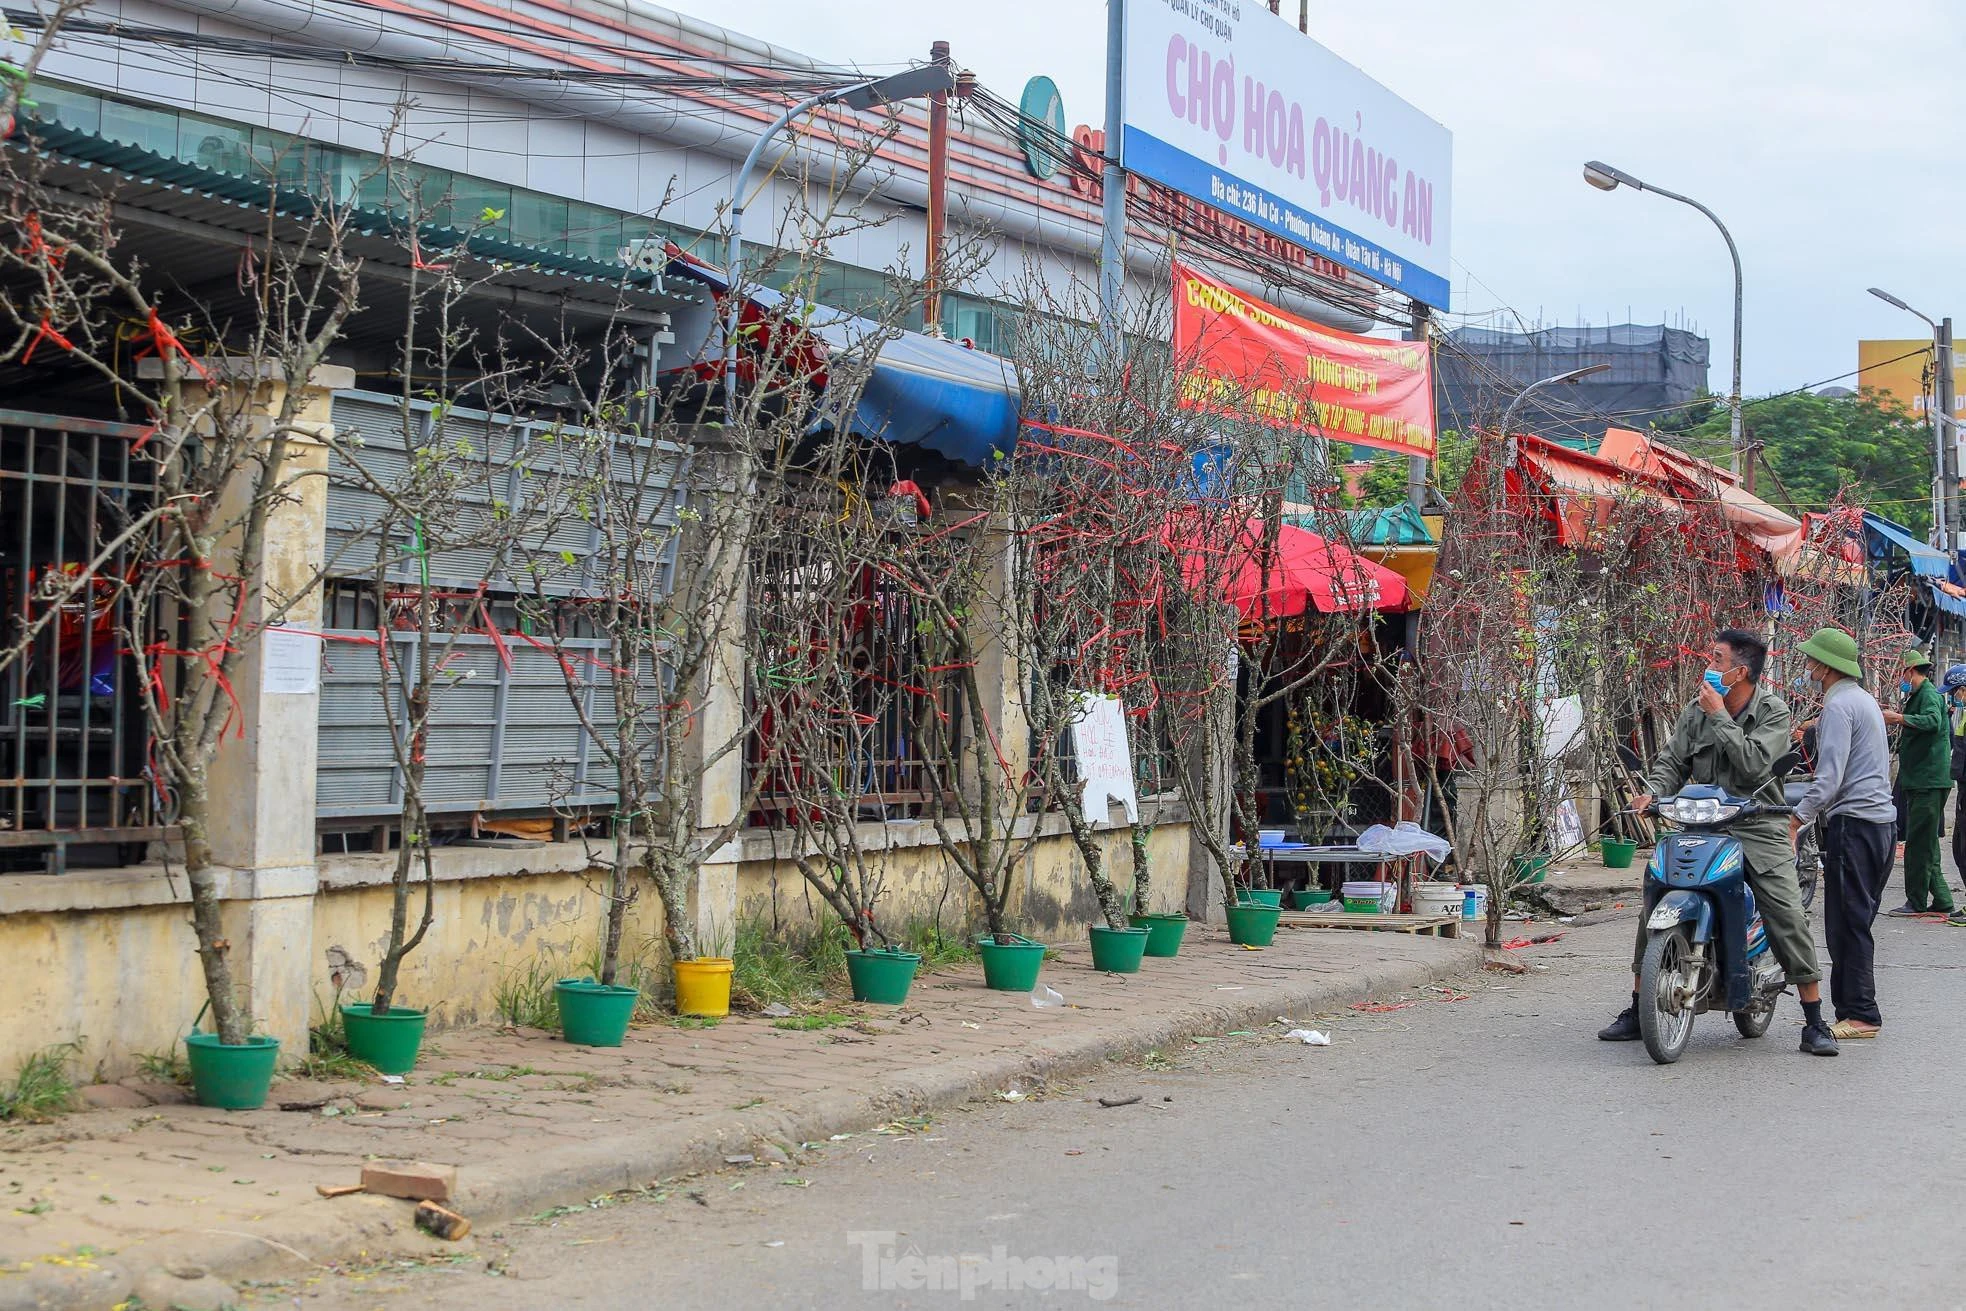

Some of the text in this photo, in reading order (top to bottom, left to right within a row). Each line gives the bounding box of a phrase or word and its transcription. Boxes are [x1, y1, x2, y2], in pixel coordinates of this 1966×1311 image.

[1200, 10, 1214, 34] CHỢ
[1215, 20, 1233, 43] QUẬN
[1166, 33, 1236, 166] CHỢ
[1244, 75, 1305, 180] HOA
[1312, 110, 1398, 228] QUẢNG
[1402, 170, 1432, 246] AN
[1211, 175, 1224, 203] Địa
[1242, 190, 1257, 214] 236
[1258, 193, 1268, 219] Âu
[1269, 202, 1279, 224] Cơ
[1285, 209, 1310, 242] Phường
[1311, 224, 1331, 251] Quảng
[1332, 232, 1340, 253] An
[1345, 238, 1360, 264] Quận
[1361, 245, 1371, 268] Tây
[1372, 250, 1380, 271] Hồ
[1384, 257, 1392, 277] Hà
[1392, 261, 1402, 284] Nội
[1306, 353, 1342, 388] THÔNG
[1367, 371, 1378, 397] 5K
[1343, 408, 1365, 435] TRUNG
